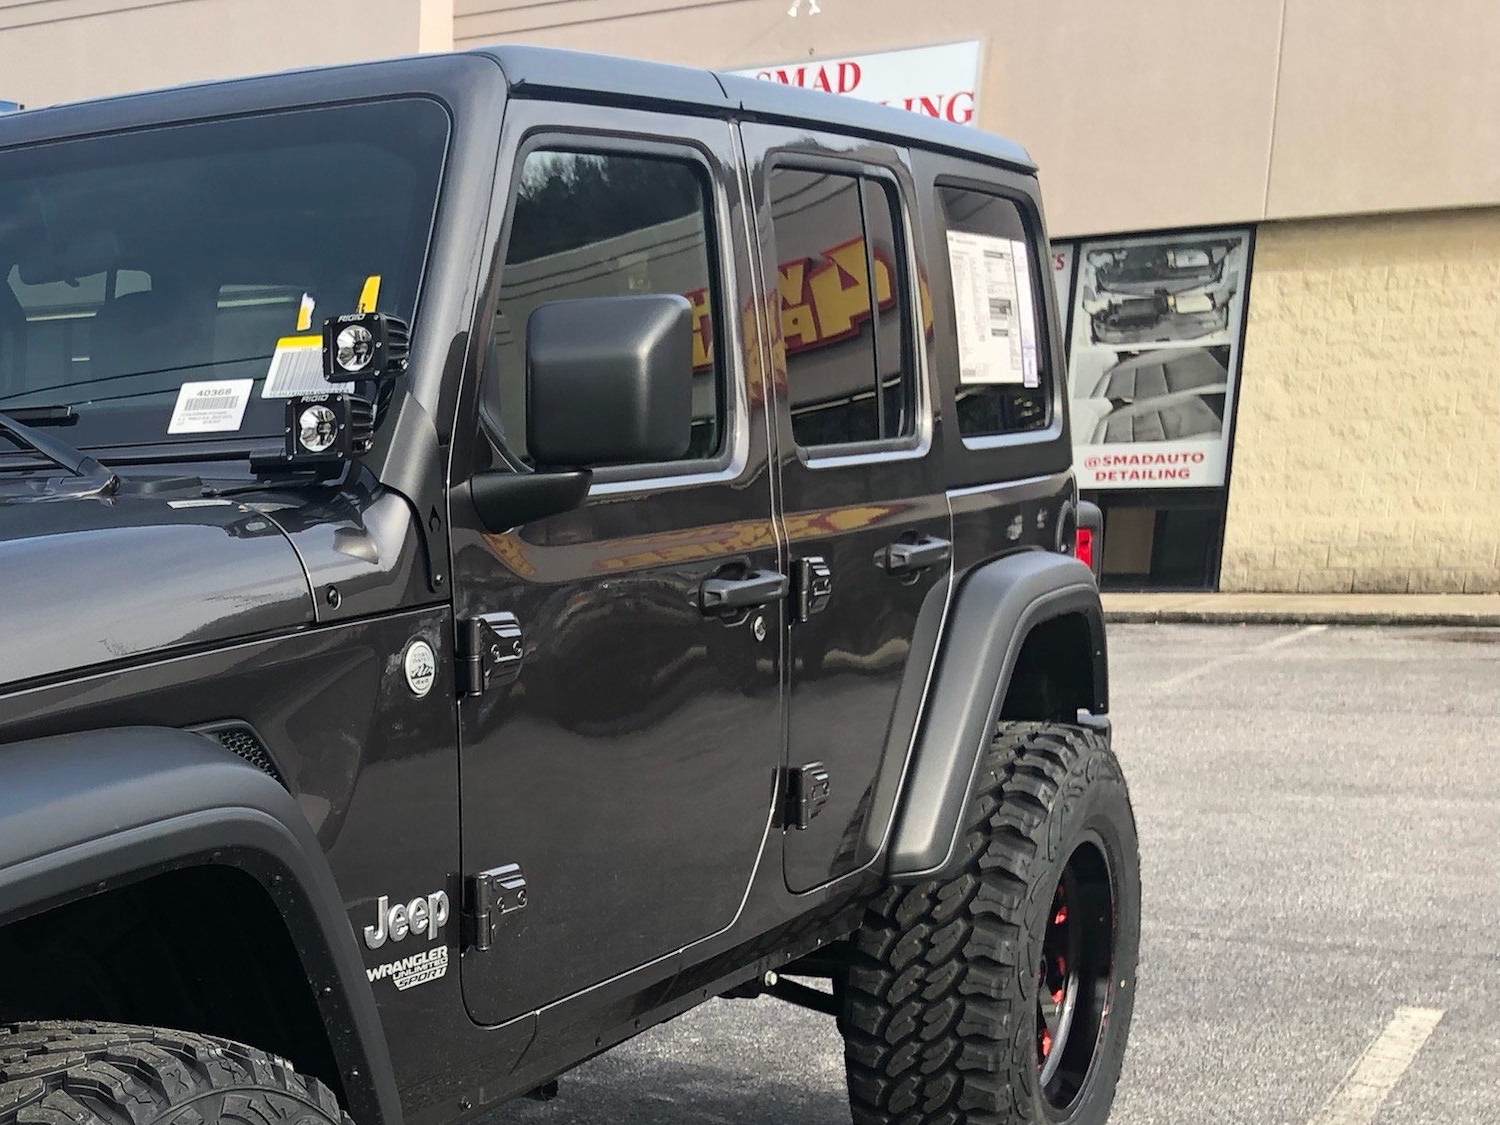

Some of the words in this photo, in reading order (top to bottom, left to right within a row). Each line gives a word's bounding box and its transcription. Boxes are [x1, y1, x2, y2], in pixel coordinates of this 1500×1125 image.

[337, 313, 367, 323] RIGID
[196, 388, 232, 397] 40368
[300, 394, 330, 403] RIGID
[1084, 451, 1205, 470] @SMADAUTO
[1094, 467, 1191, 482] DETAILING
[363, 889, 450, 949] Jeep
[366, 945, 448, 982] WRANGLER
[392, 957, 448, 981] UNLIMITED
[397, 966, 448, 989] SPORT
